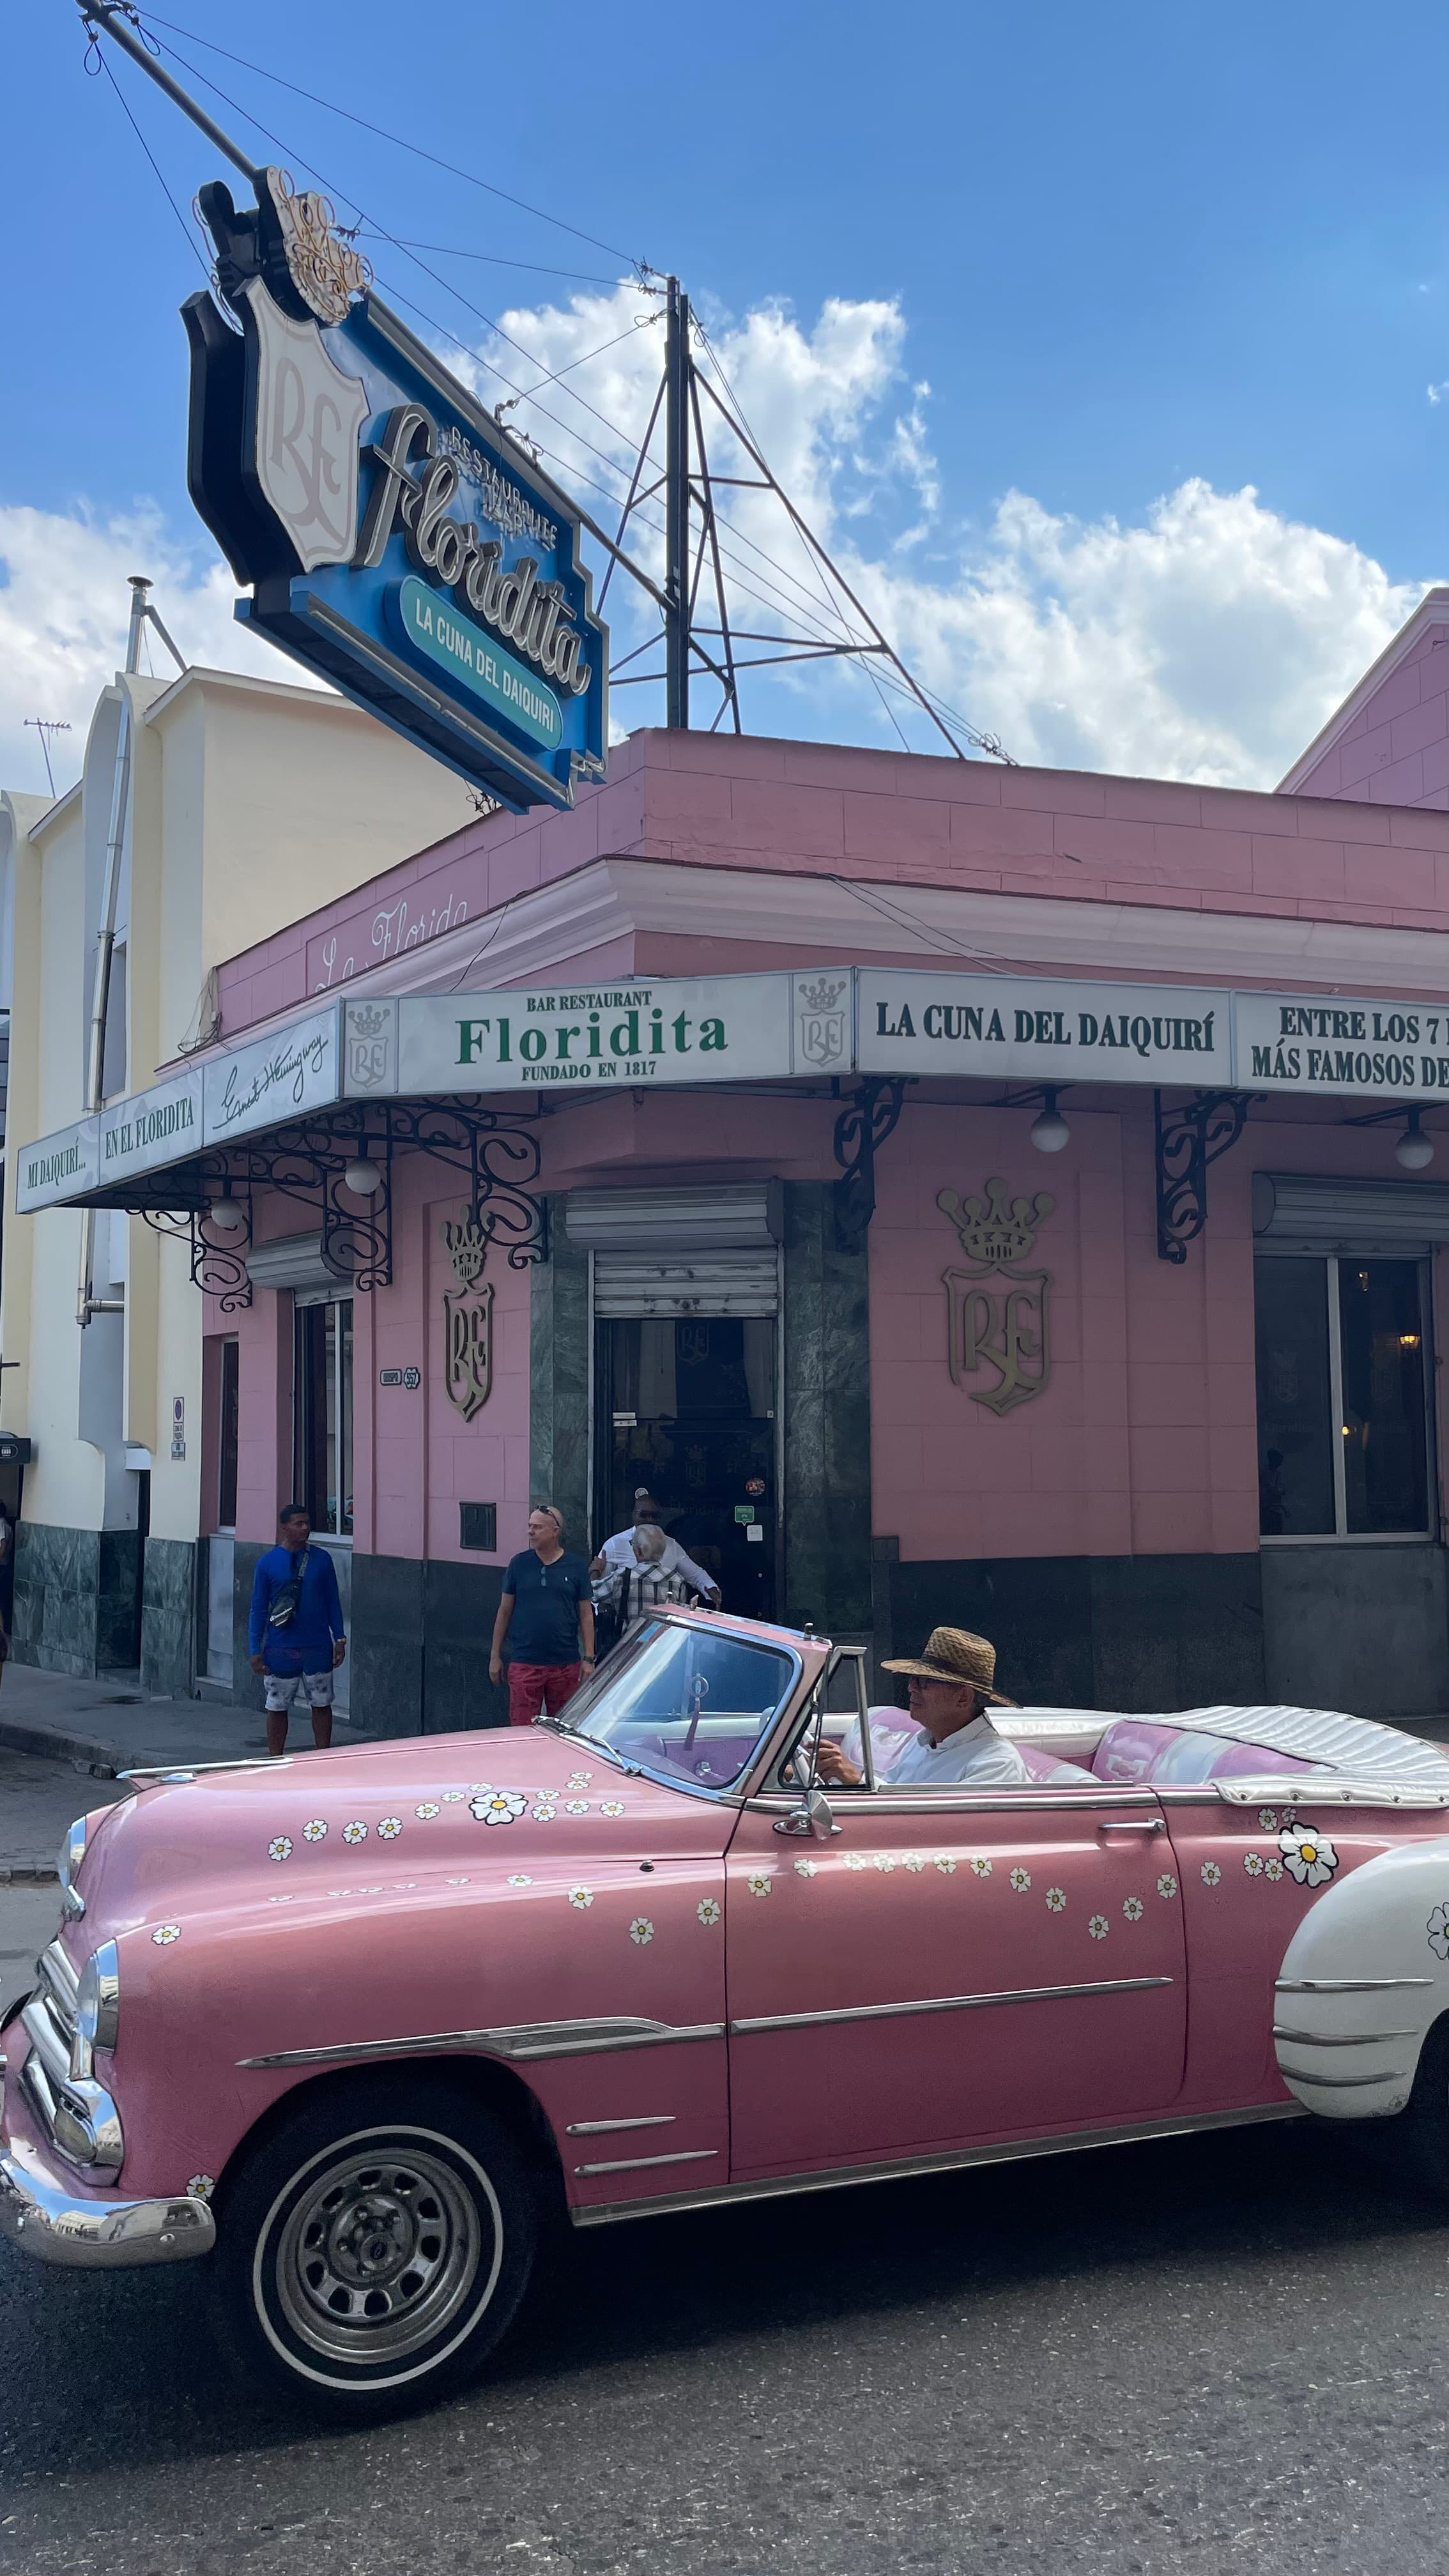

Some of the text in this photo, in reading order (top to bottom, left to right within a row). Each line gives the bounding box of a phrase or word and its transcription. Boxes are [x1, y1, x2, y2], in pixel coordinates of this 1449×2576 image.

[416, 599, 554, 733] LA CUNA DEL DAIQUIRI
[527, 991, 652, 1012] BAR RESTAURANT
[1280, 1006, 1366, 1039] ENTRE
[1372, 1013, 1420, 1044] LOS
[1427, 1018, 1439, 1045] 7
[454, 1008, 728, 1064] Floridita
[876, 1002, 1215, 1057] LA CUNA DEL DAIQUIRÍ
[521, 1061, 657, 1082] FUNDADO EN 1817
[1252, 1038, 1301, 1080] MÁS
[1307, 1048, 1414, 1086] FAMOSOS
[105, 1096, 194, 1160] EN EL FLORIDITA
[27, 1160, 38, 1190] MI
